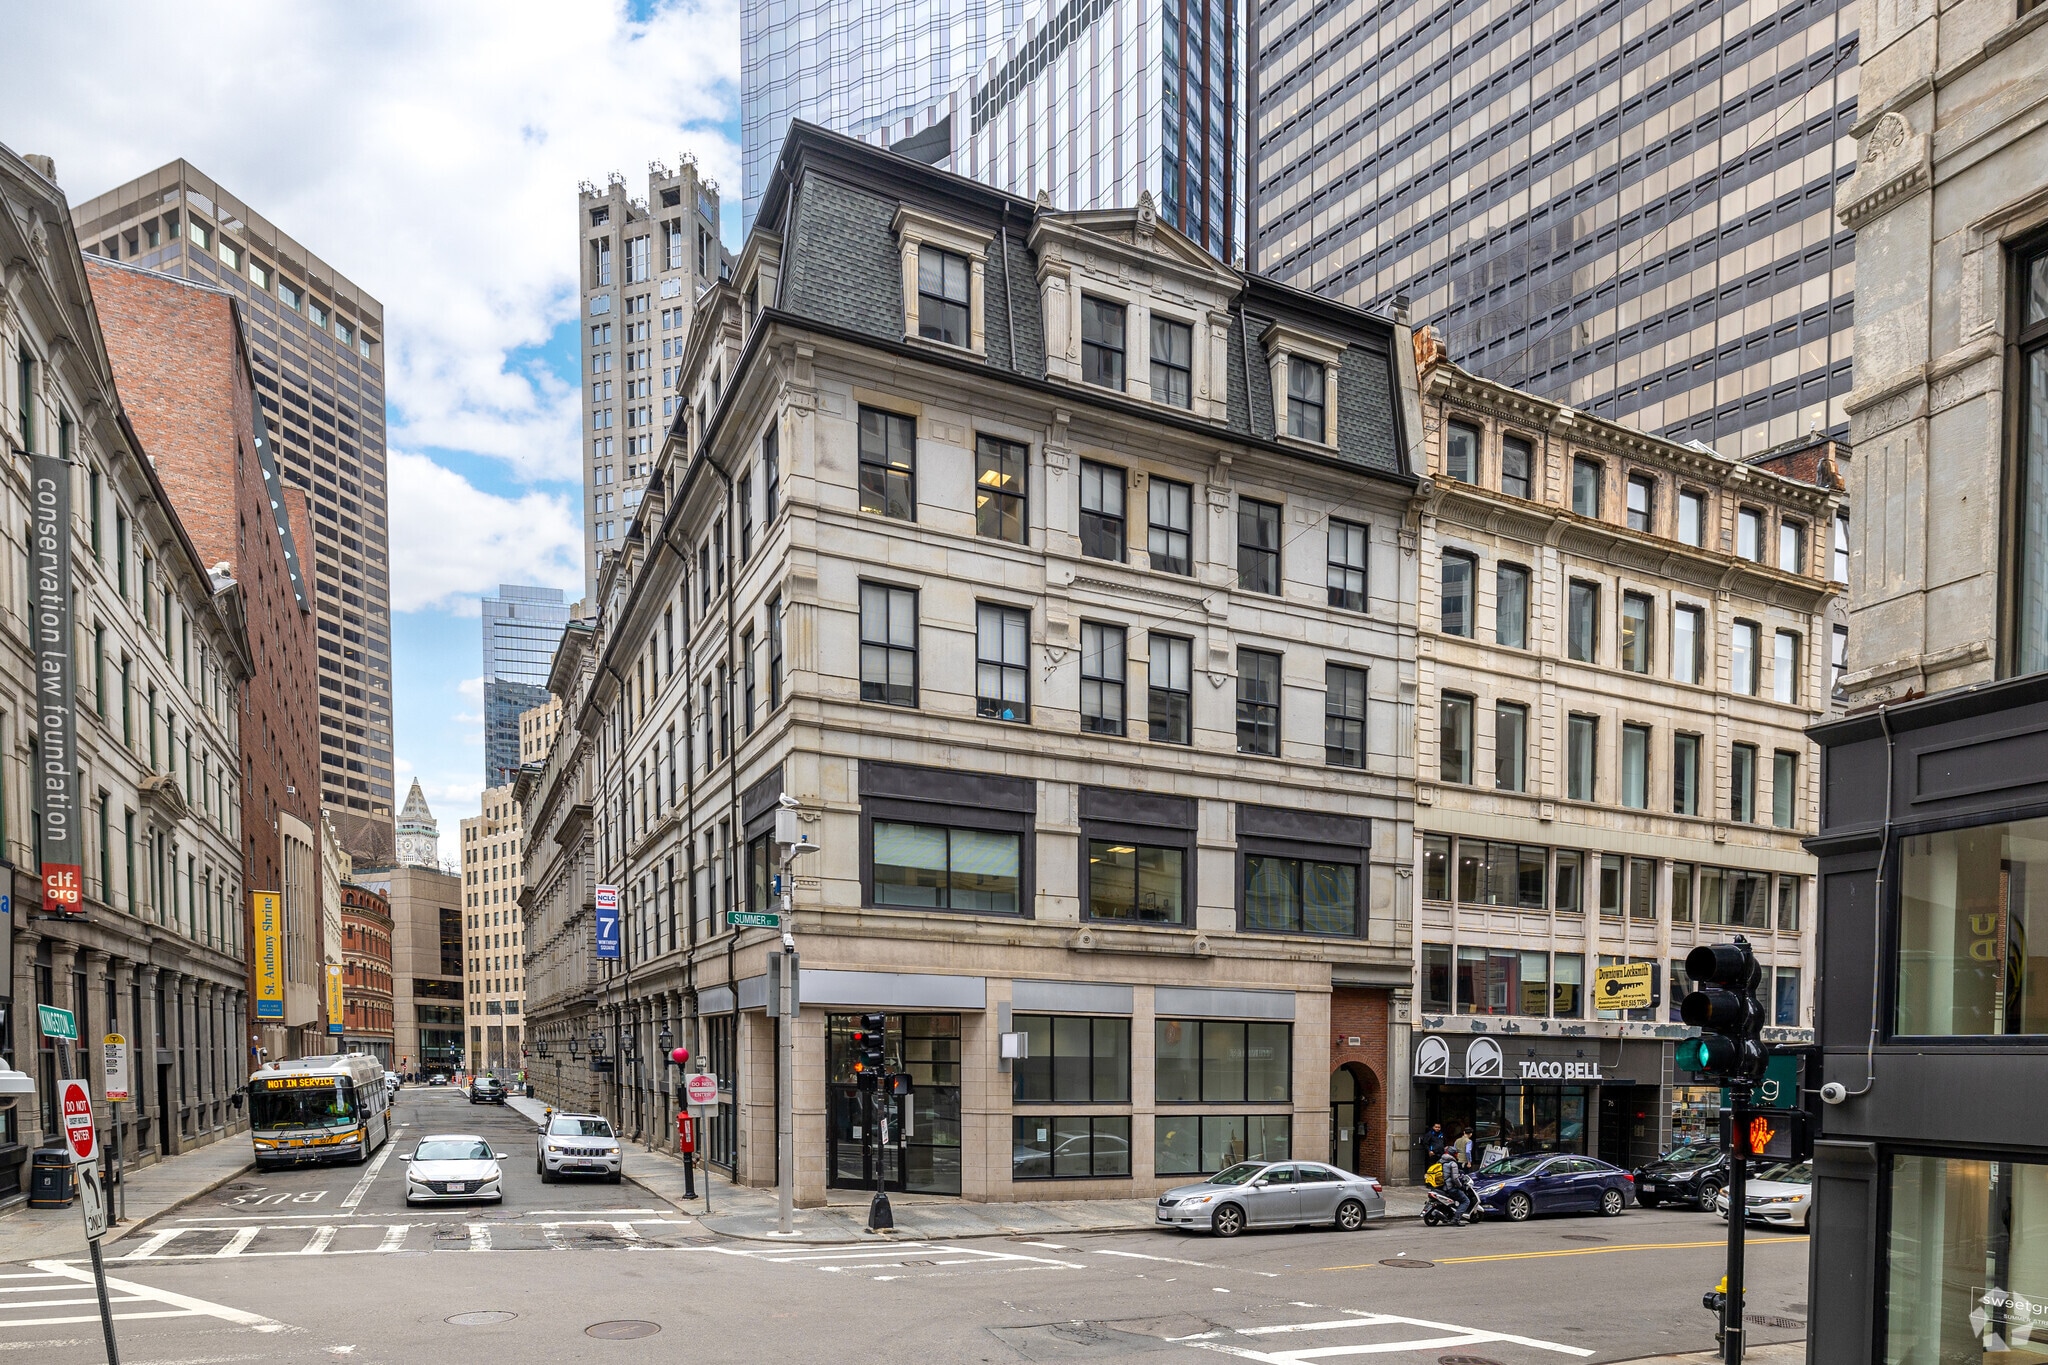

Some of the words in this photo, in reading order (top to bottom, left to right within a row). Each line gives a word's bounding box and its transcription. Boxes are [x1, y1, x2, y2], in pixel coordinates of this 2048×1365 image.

[38, 478, 65, 642] conservation
[42, 651, 67, 697] law
[43, 704, 72, 841] foundation
[47, 872, 78, 888] clf.
[47, 889, 78, 903] org
[262, 897, 273, 932] Shrine
[734, 914, 766, 925] SUMMER
[599, 917, 615, 938] 7
[263, 934, 277, 979] Anthony
[1599, 968, 1623, 980] Downtown
[1624, 963, 1649, 978] Locksmith
[264, 982, 275, 995] St.
[40, 1010, 71, 1034] KINGSTON
[1519, 1061, 1563, 1078] TACO
[1564, 1062, 1602, 1078] BELL
[267, 1079, 285, 1089] NOT
[286, 1079, 297, 1088] IN
[299, 1077, 335, 1087] SERVICE
[65, 1101, 75, 1112] DO
[76, 1100, 87, 1111] NOT
[73, 1129, 90, 1142] ENTER
[221, 1187, 329, 1206] BUS
[87, 1213, 103, 1231] ONLY
[2003, 1314, 2031, 1322] SUMMER
